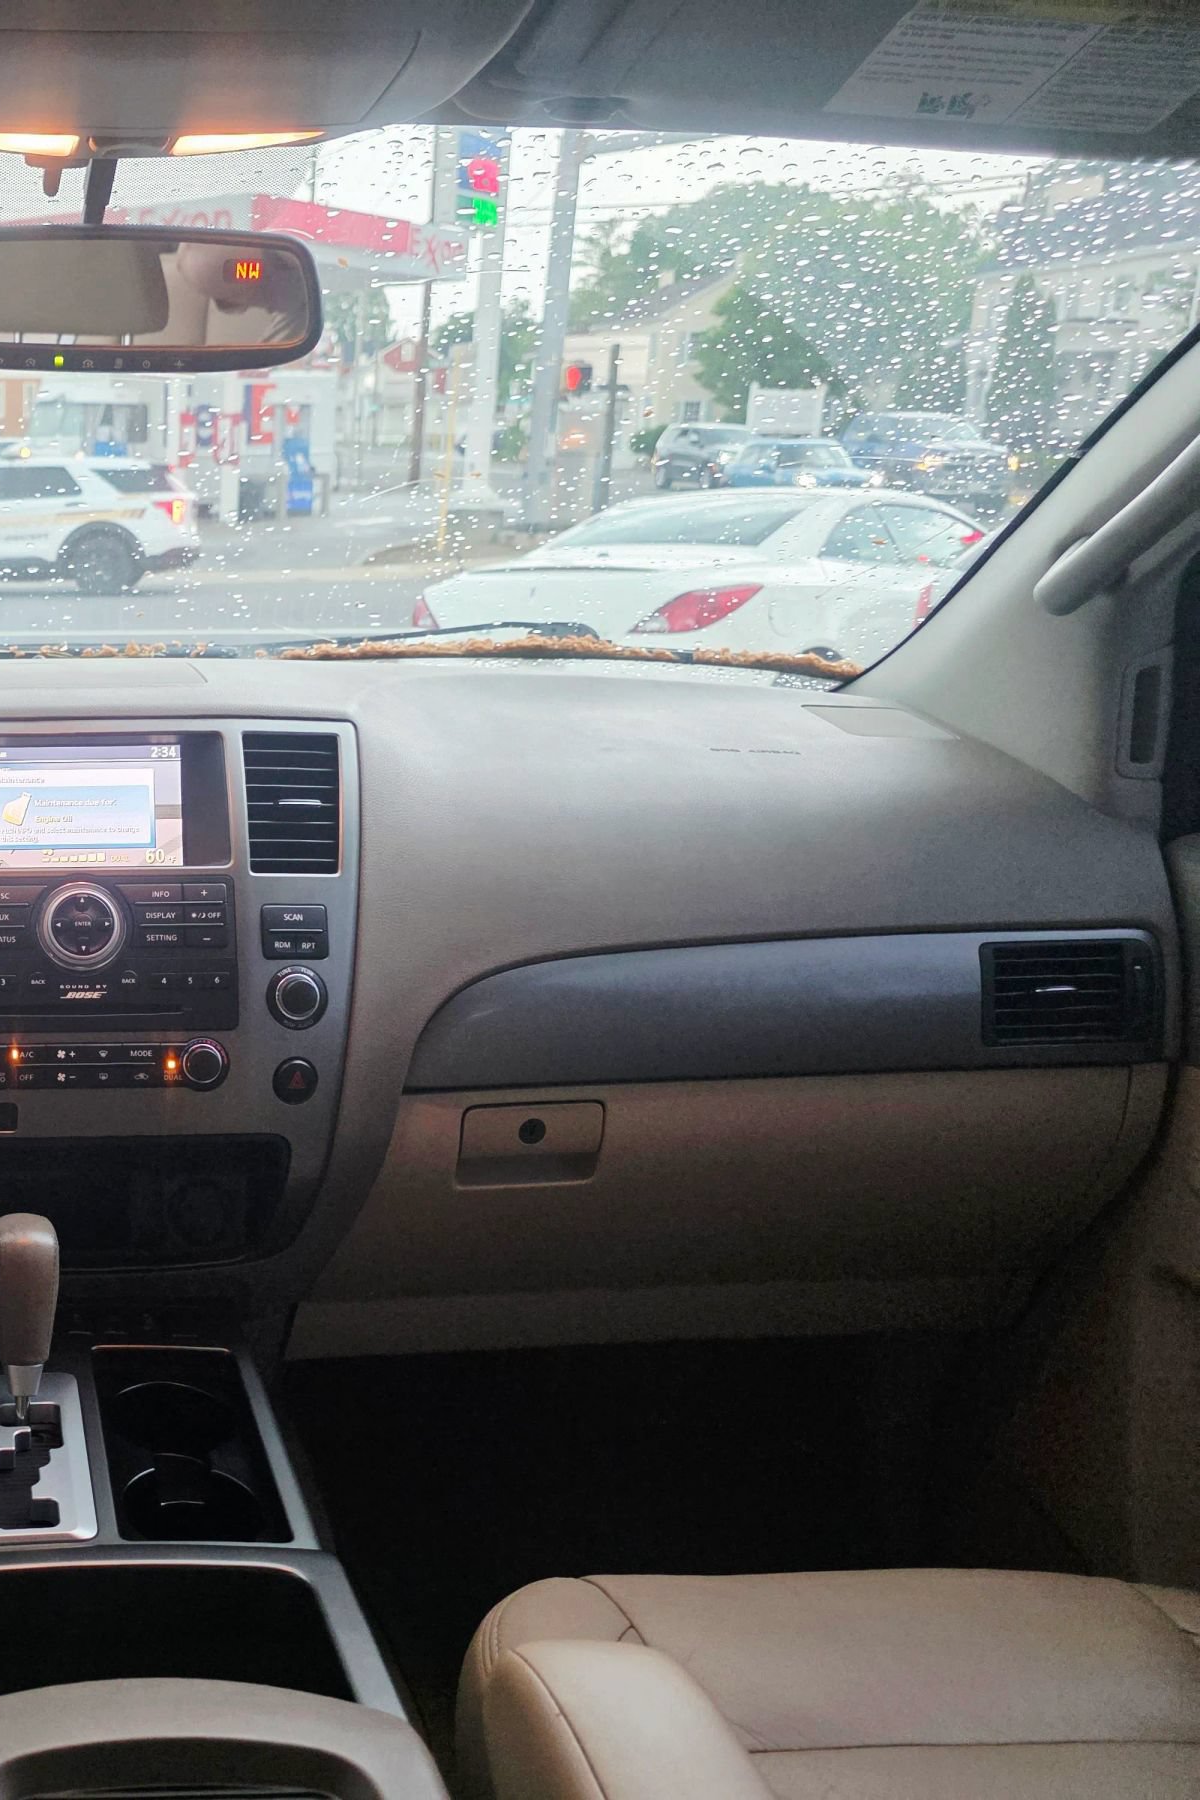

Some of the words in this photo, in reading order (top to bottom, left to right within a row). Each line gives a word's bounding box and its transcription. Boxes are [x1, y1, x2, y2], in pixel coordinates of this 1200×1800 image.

[236, 262, 260, 279] NW
[150, 745, 177, 758] 2:34
[34, 799, 84, 807] Maintenance
[36, 815, 62, 825] Engine
[145, 849, 166, 864] 60
[151, 890, 170, 898] INFO
[145, 911, 176, 919] DISPLAY
[207, 911, 221, 919] OFF
[145, 934, 178, 942] SETTING
[1, 978, 6, 986] 3
[188, 977, 193, 985] 5
[60, 991, 107, 999] BOSE
